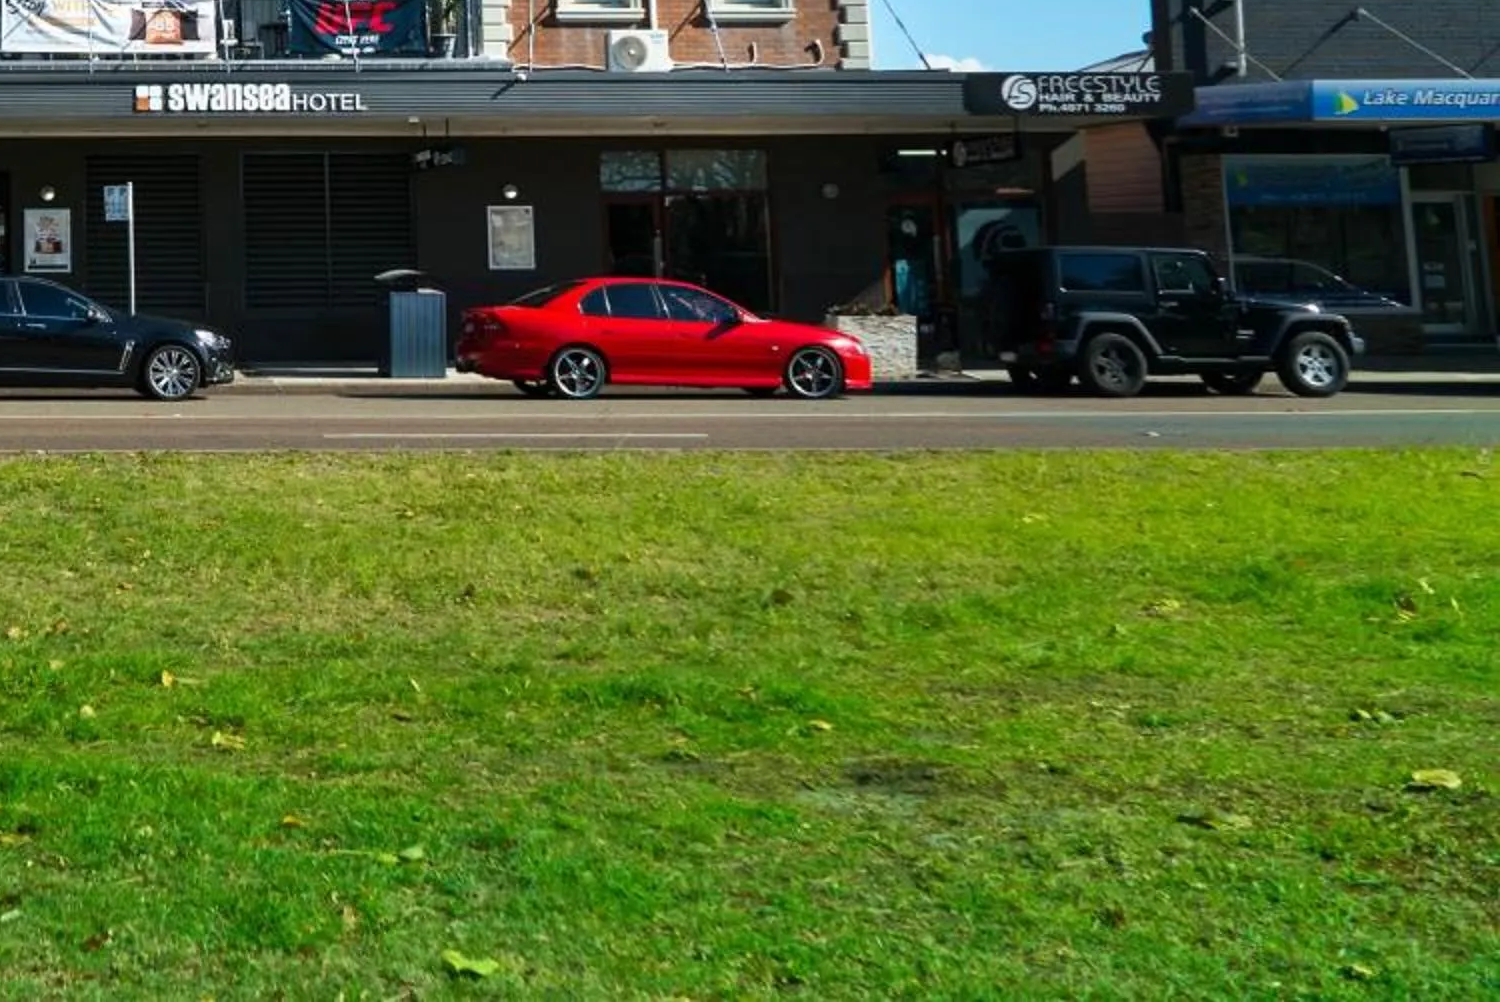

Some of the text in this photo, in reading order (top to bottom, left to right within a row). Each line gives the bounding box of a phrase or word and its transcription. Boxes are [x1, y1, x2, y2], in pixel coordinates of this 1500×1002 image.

[1037, 75, 1161, 93] FREESTYLE
[168, 84, 368, 111] swansea HOTEL
[1039, 93, 1161, 103] HAIR & BEAUTY
[1363, 89, 1408, 105] Lake
